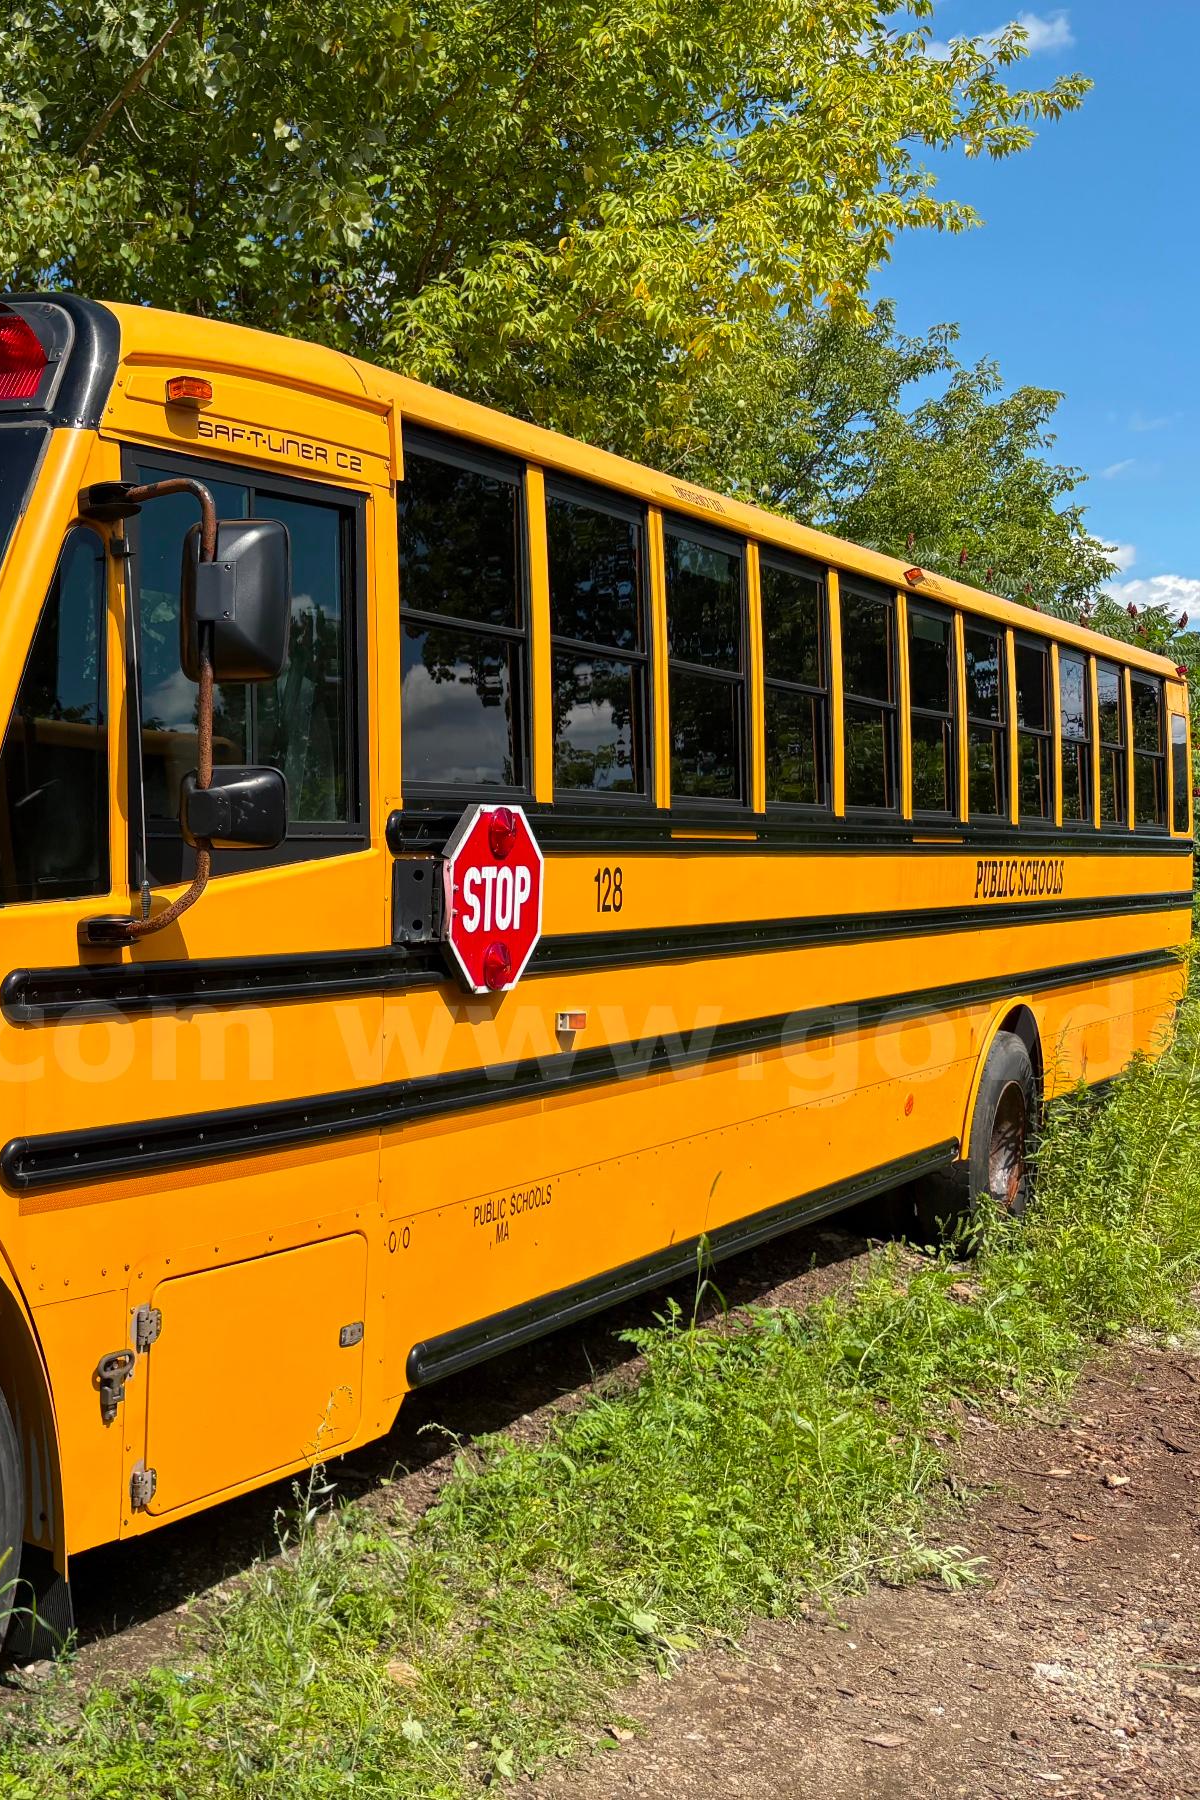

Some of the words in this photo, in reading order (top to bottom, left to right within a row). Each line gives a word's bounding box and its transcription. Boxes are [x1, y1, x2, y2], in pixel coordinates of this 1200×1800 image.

[336, 451, 362, 473] C2
[462, 865, 531, 933] STOP
[594, 867, 623, 912] 128
[974, 860, 1017, 898] PUBLIC
[1018, 859, 1064, 896] SCHOOLS
[473, 1198, 506, 1227] PUBLIC
[509, 1184, 552, 1216] SCHOOLS
[495, 1220, 510, 1244] MA
